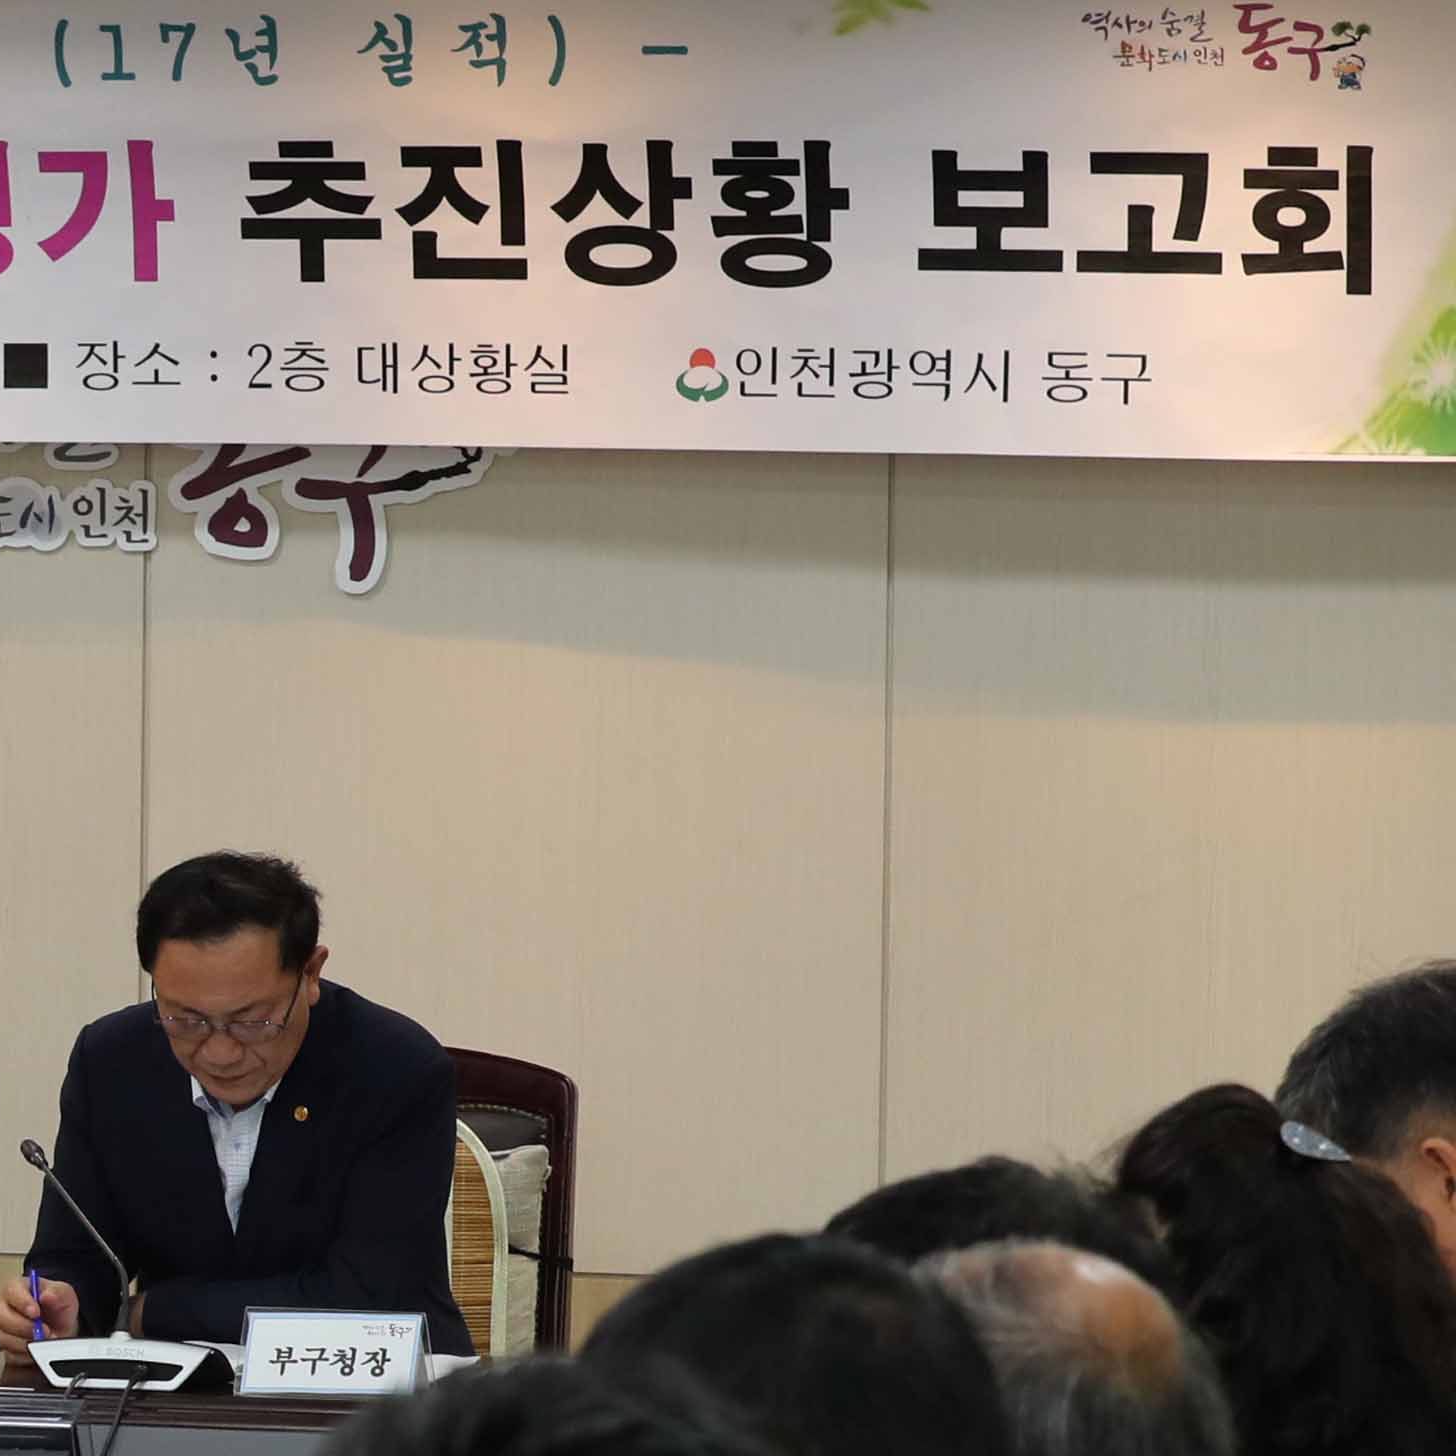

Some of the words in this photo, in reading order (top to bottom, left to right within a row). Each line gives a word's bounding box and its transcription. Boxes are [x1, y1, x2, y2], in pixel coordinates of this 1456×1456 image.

[54, 14, 281, 89] (17년
[1082, 11, 1153, 41] 역사의
[1159, 9, 1213, 43] 숨결
[1233, 3, 1325, 81] 동구
[1113, 39, 1188, 72] 문화도시
[1192, 47, 1226, 67] 인천
[240, 138, 851, 290] 추진상황
[917, 144, 1375, 297] 보고회
[75, 341, 183, 393] 장소
[247, 342, 332, 394] 2층
[356, 341, 571, 396] 대상황실
[734, 346, 1012, 405] 인천광역시
[1041, 352, 1154, 406] 동구
[71, 486, 151, 544] 인천
[269, 1346, 391, 1377] 부구청장
